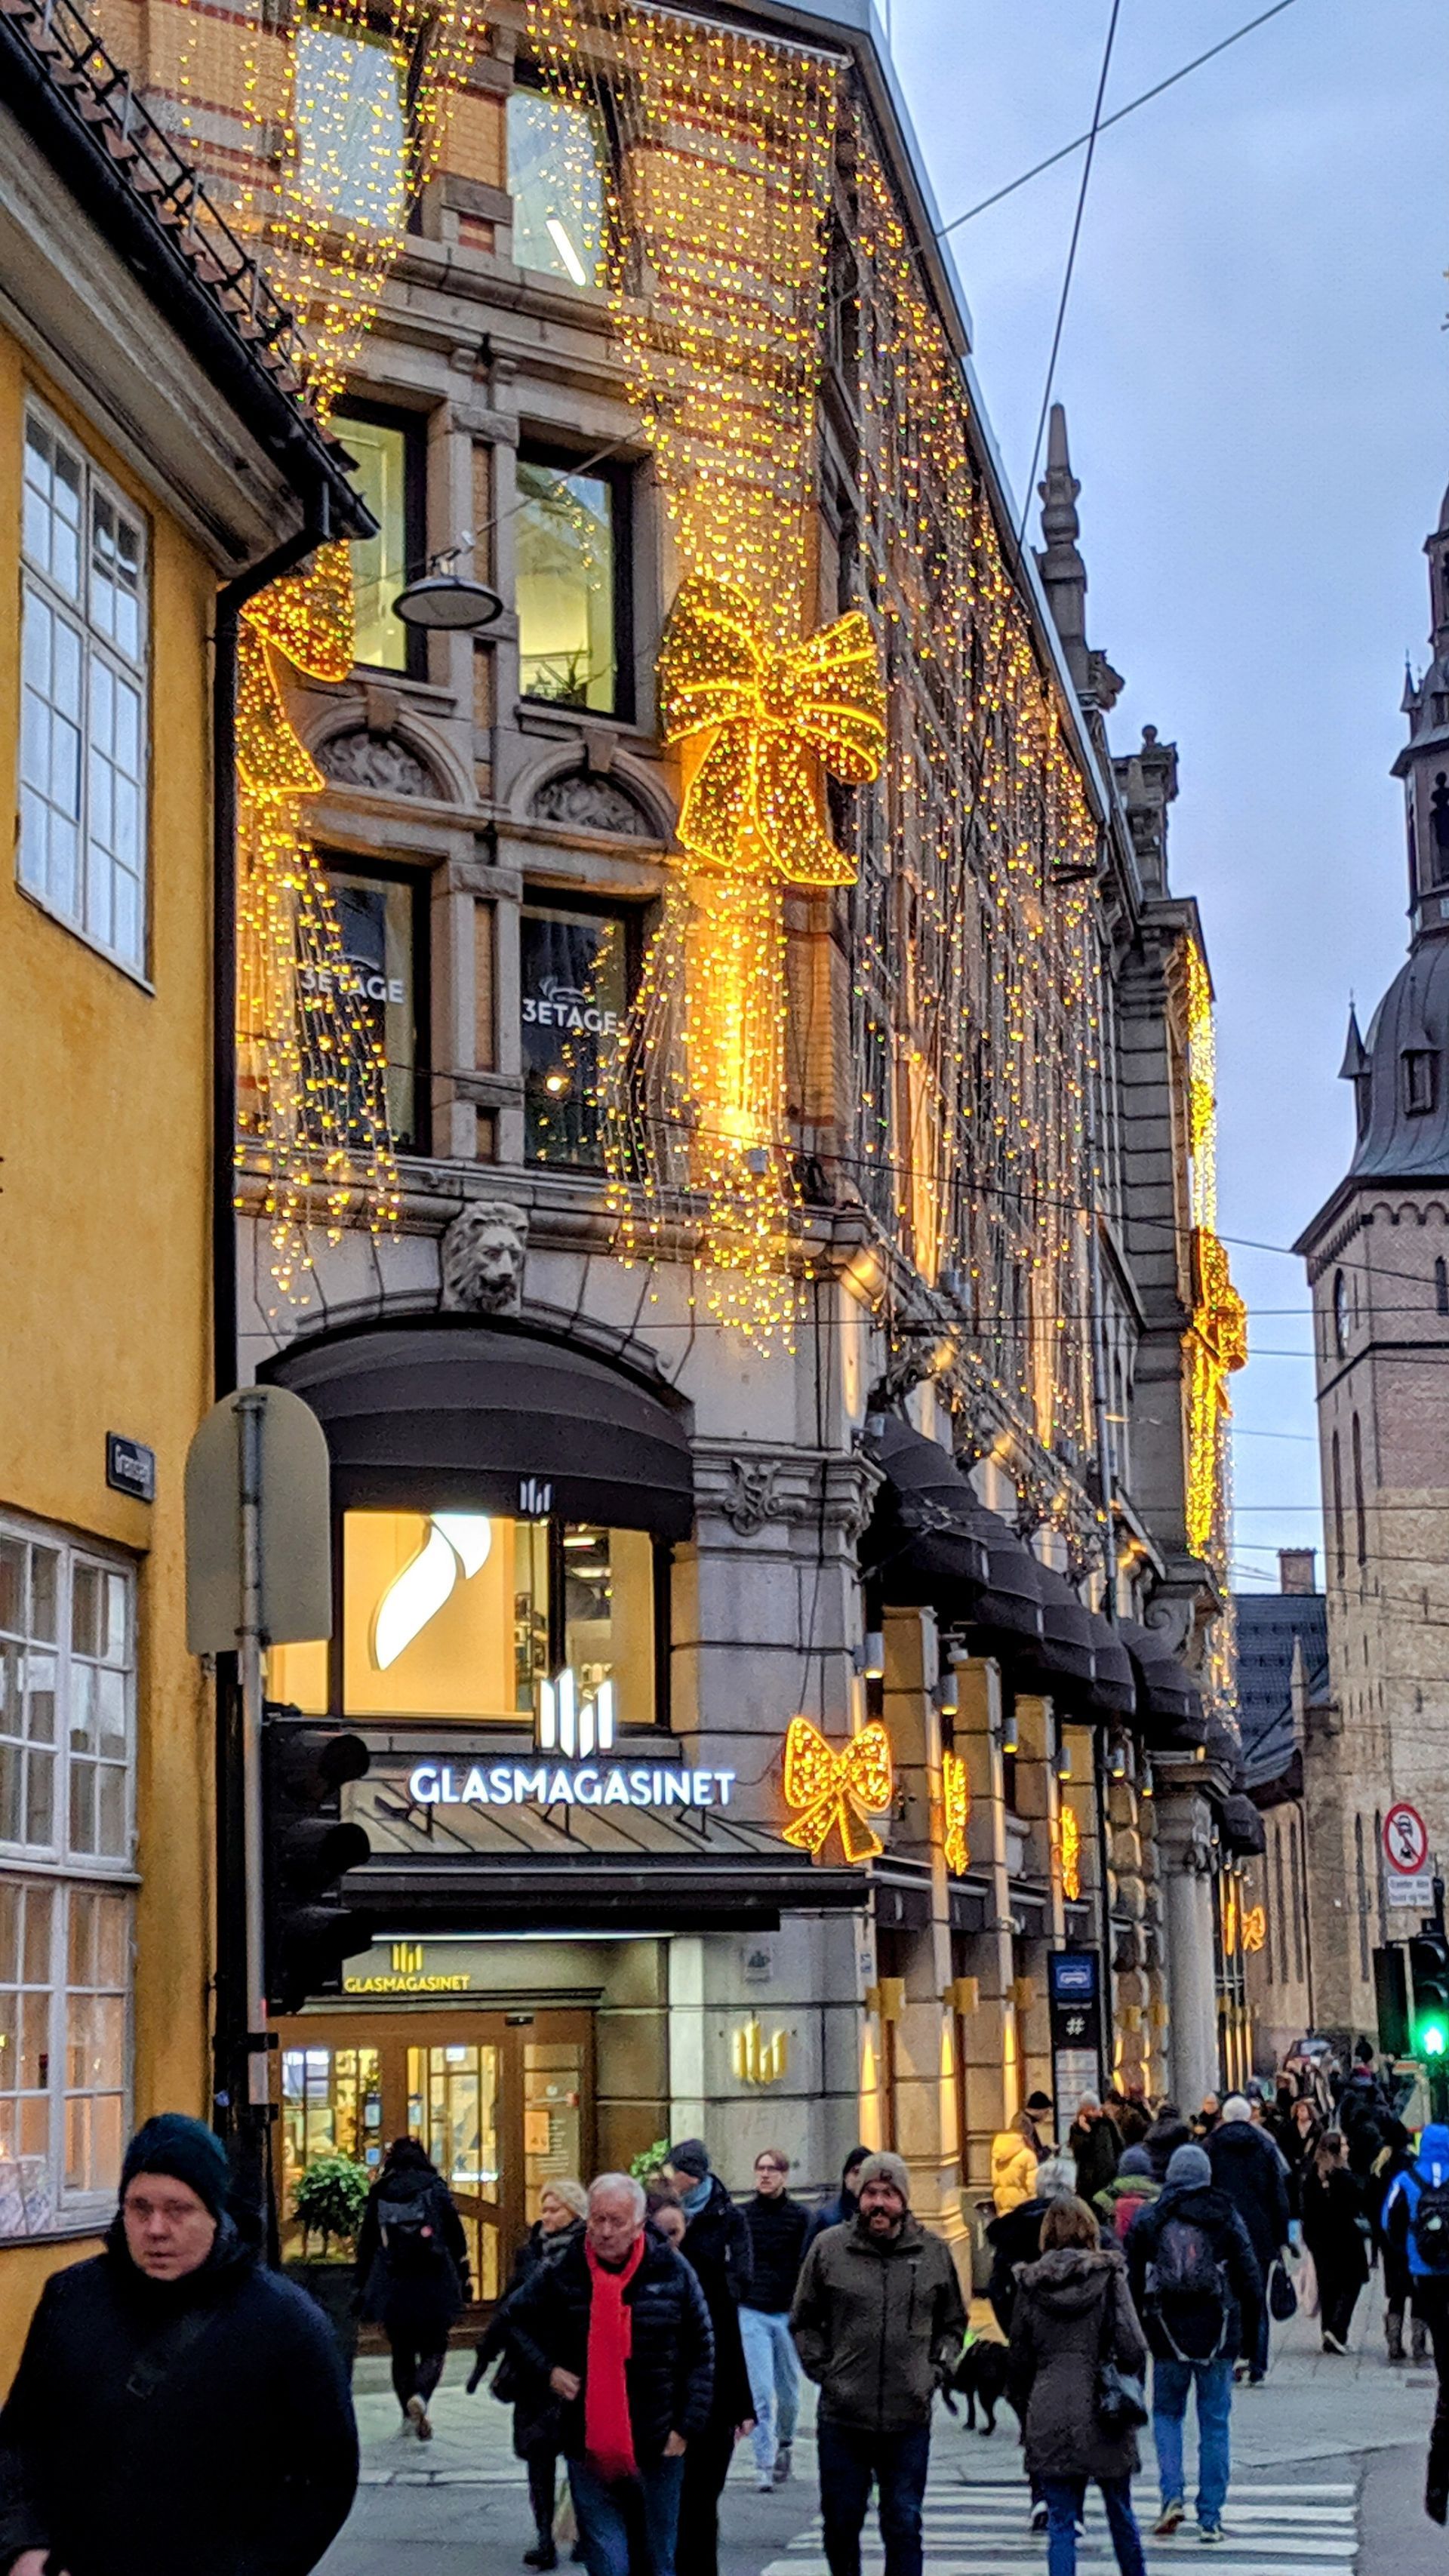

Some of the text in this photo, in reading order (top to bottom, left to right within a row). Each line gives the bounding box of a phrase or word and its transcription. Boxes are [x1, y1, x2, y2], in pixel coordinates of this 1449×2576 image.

[521, 997, 617, 1035] 3ETAGE
[409, 1767, 736, 1806] GLASMAGASINET
[345, 1974, 470, 1993] GLASMAGASINET
